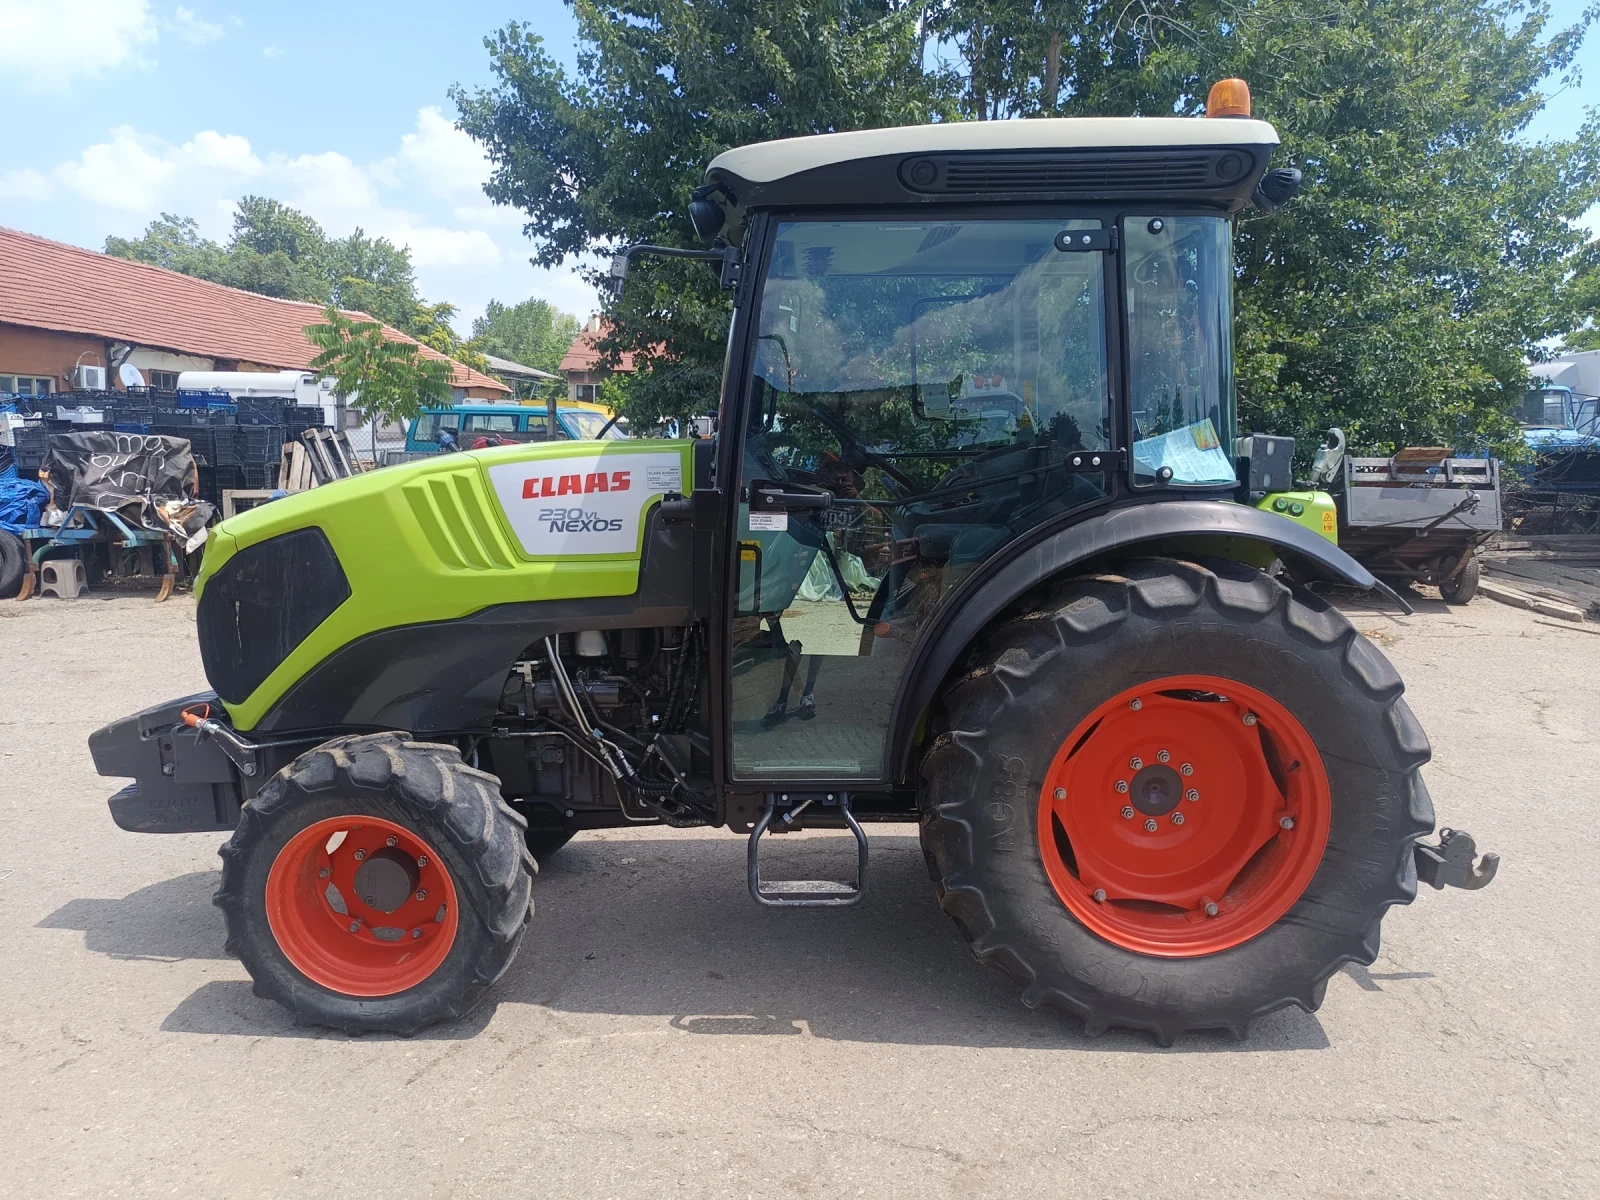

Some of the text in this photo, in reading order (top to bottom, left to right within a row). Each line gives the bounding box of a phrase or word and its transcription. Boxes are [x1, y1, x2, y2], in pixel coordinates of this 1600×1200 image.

[522, 471, 631, 499] CLAAS
[538, 508, 601, 521] 230 VL
[549, 519, 623, 533] NEXOS
[985, 753, 1026, 853] AC85
[150, 813, 167, 823] 30
